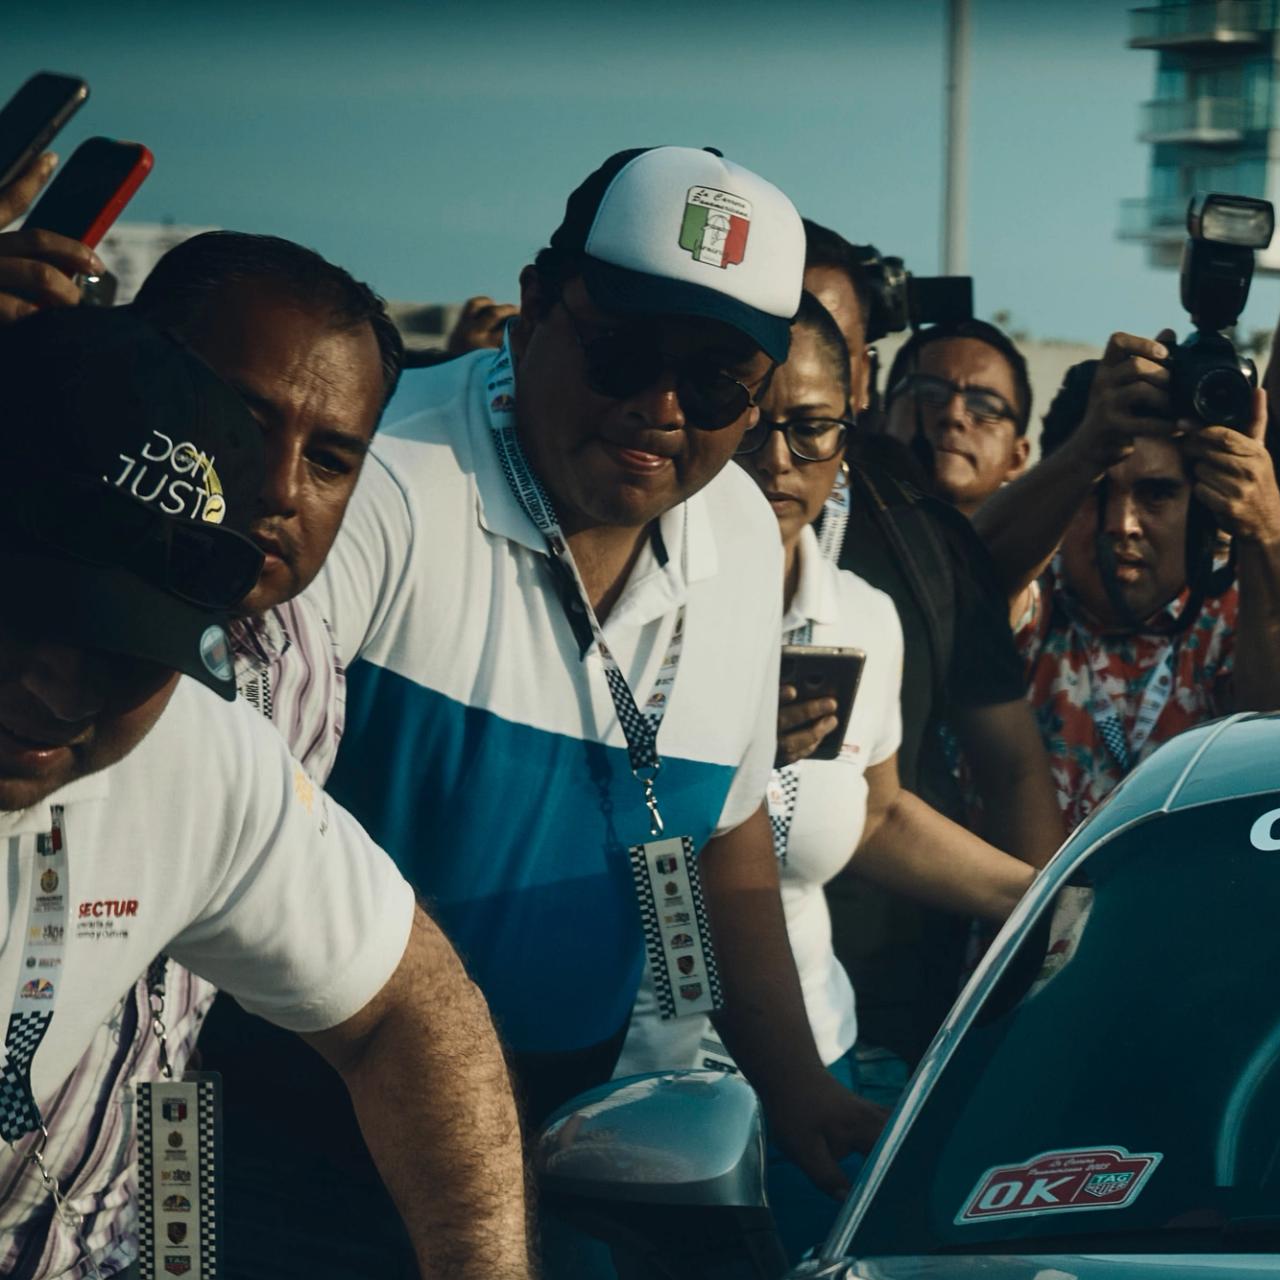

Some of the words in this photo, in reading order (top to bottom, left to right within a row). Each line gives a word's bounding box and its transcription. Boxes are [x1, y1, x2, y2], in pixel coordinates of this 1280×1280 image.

[79, 900, 138, 919] SECTUR
[1095, 1173, 1129, 1184] TAG
[978, 1175, 1075, 1209] OK
